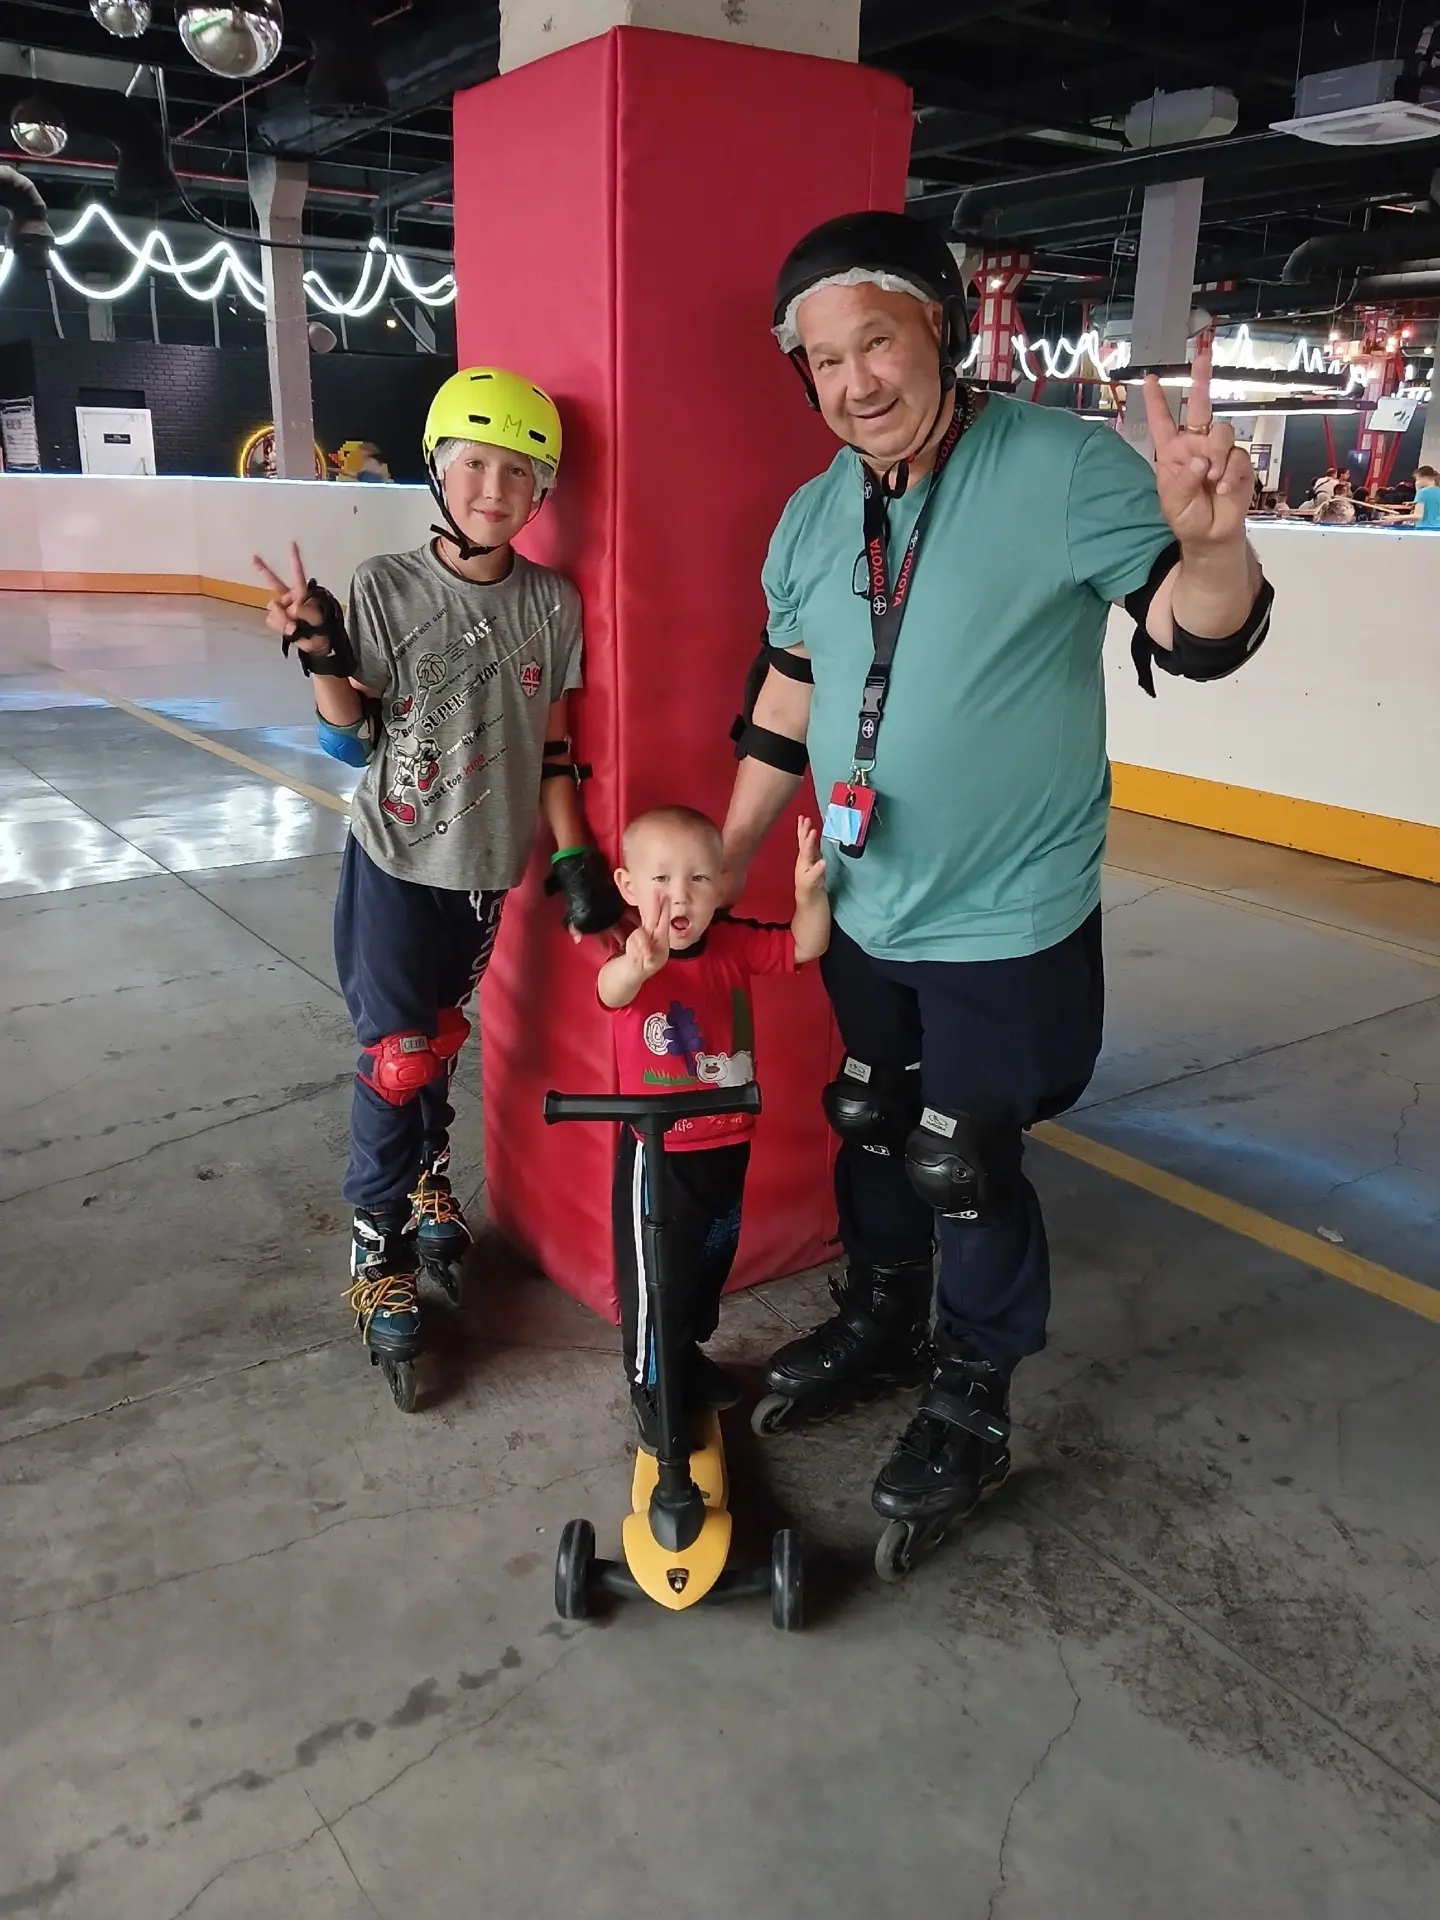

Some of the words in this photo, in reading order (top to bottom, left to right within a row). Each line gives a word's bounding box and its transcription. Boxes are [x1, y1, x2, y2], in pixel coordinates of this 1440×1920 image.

[502, 413, 523, 438] M
[870, 538, 885, 595] TOYOTA
[892, 549, 914, 608] TOYOTA
[420, 692, 466, 735] SUPER
[474, 660, 499, 686] TOP
[421, 785, 447, 808] best
[446, 772, 463, 789] top
